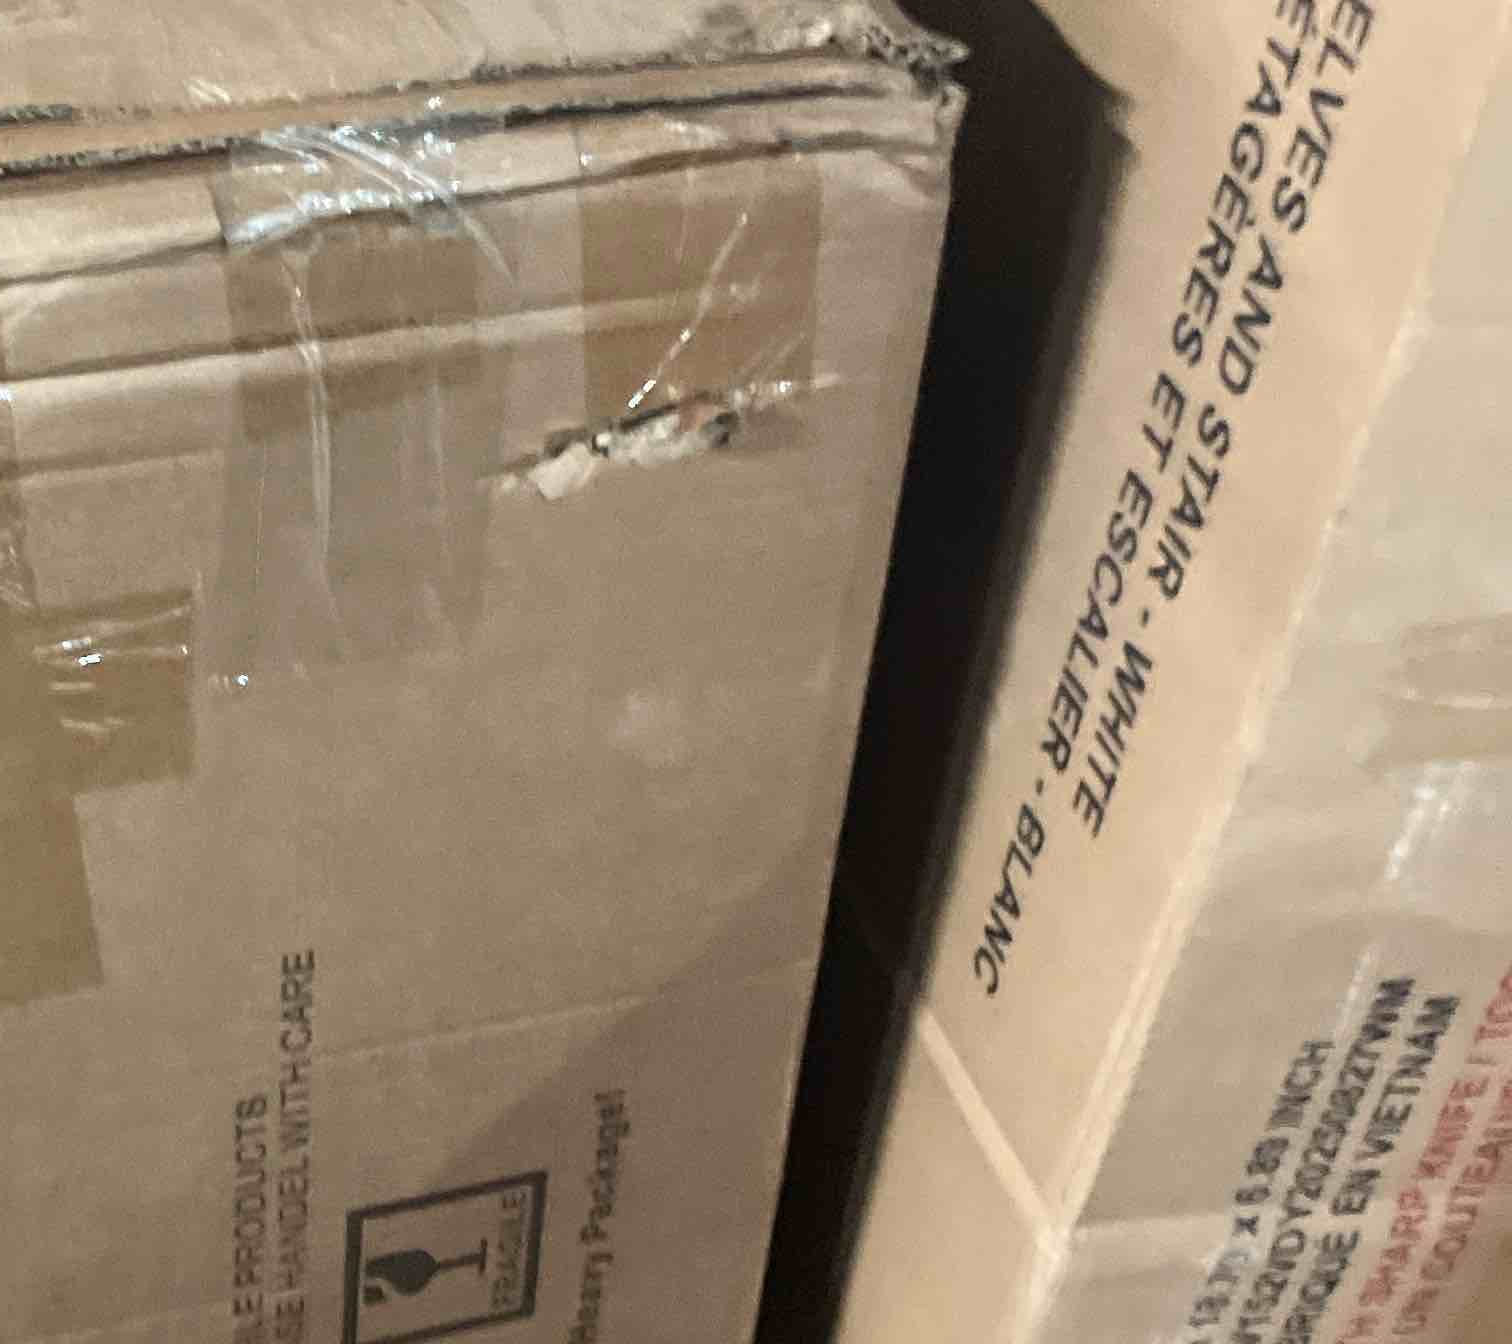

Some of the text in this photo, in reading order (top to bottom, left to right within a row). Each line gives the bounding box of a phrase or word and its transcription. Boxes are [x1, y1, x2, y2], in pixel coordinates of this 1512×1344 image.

[1217, 233, 1284, 395] AND
[1142, 372, 1185, 472] ET
[1147, 403, 1232, 601] STAIR
[1040, 467, 1154, 775] ESCALIER
[1070, 638, 1154, 838] WHITE
[974, 802, 1046, 999] BLANC
[278, 950, 314, 1058] CARE
[1356, 994, 1460, 1160] VIETNAM
[234, 1093, 268, 1286] PRODUCTS
[278, 1061, 312, 1152] WITH
[1332, 1168, 1382, 1216] EN
